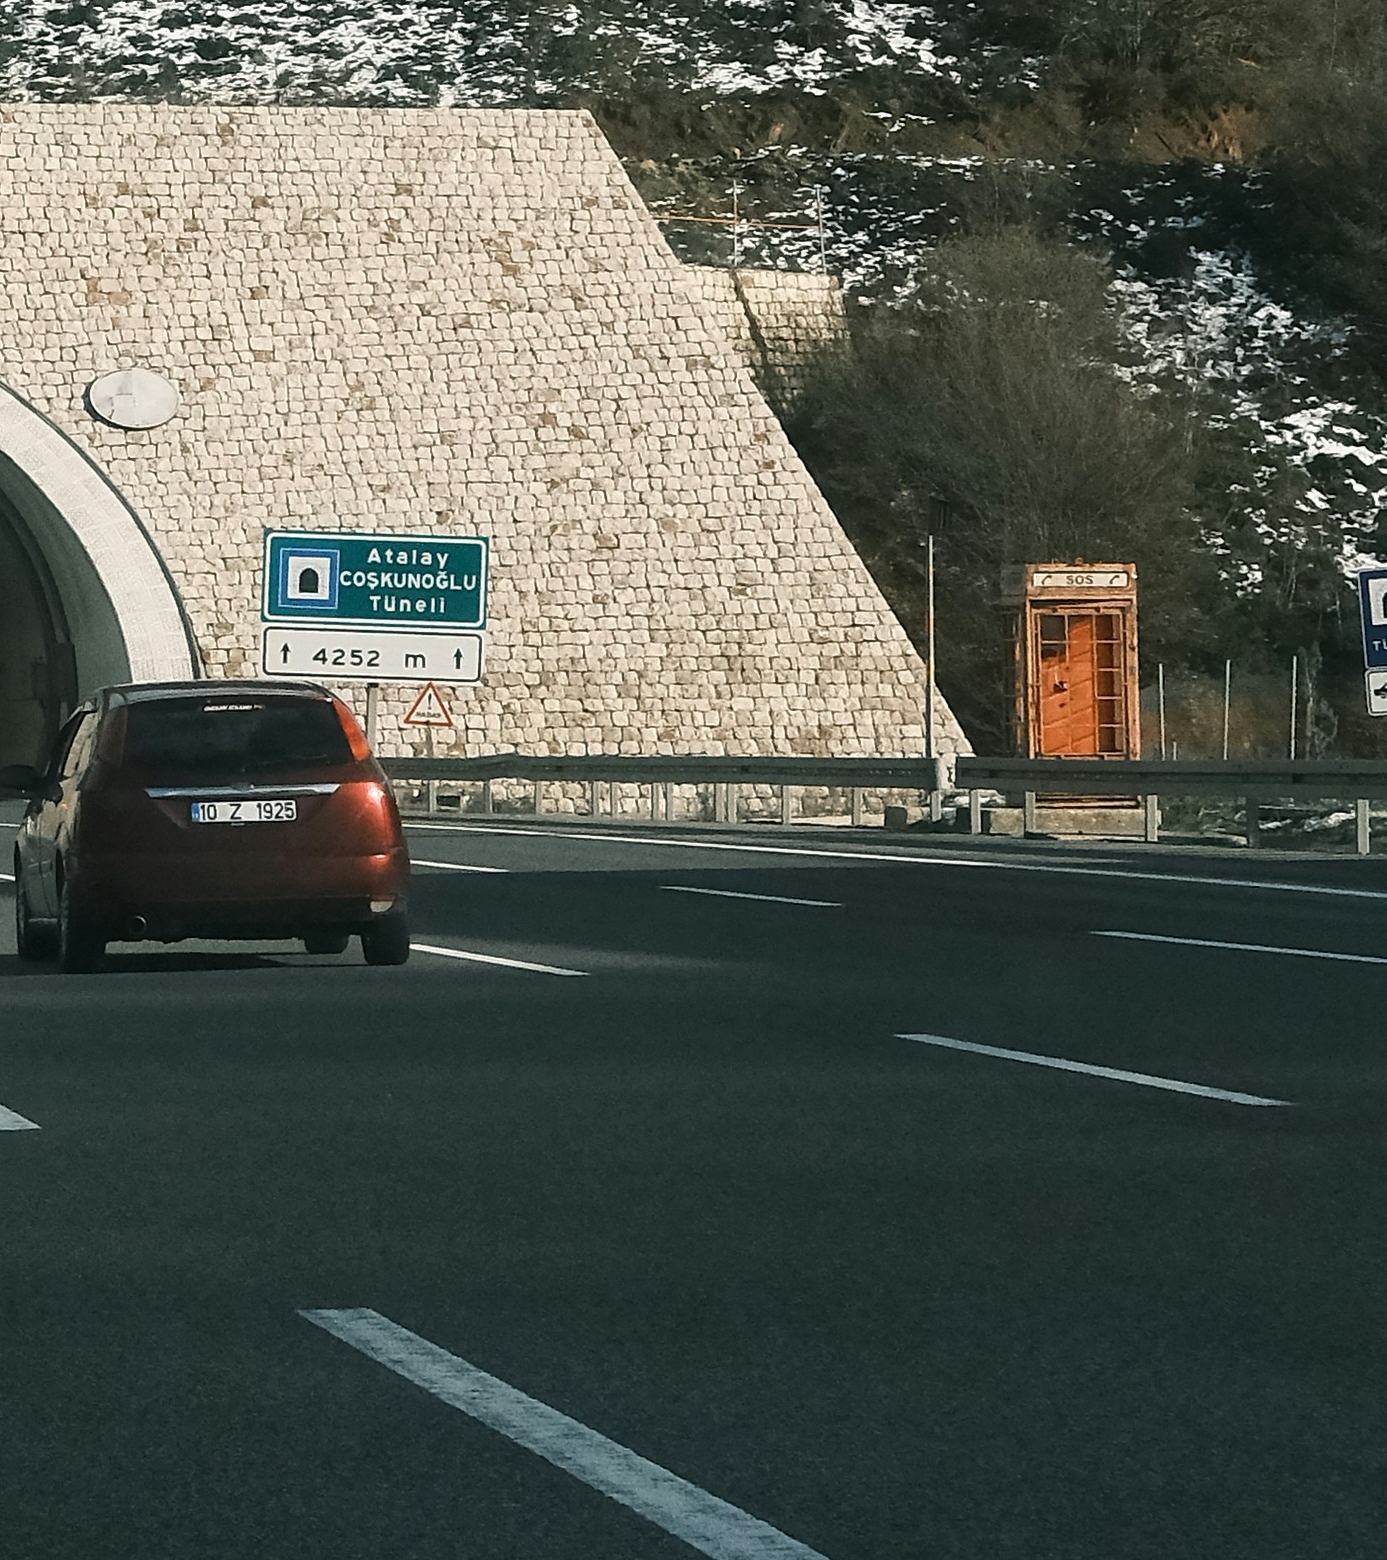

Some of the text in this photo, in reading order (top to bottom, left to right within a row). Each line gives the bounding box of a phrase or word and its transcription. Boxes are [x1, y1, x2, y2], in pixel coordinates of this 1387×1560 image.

[367, 547, 449, 570] Atalay
[339, 570, 476, 591] COŞKUNOĞLU
[1066, 575, 1094, 585] SOS
[369, 594, 446, 614] Tüneli
[312, 648, 426, 669] 4252 m
[200, 802, 295, 821] 10 Z 1925
